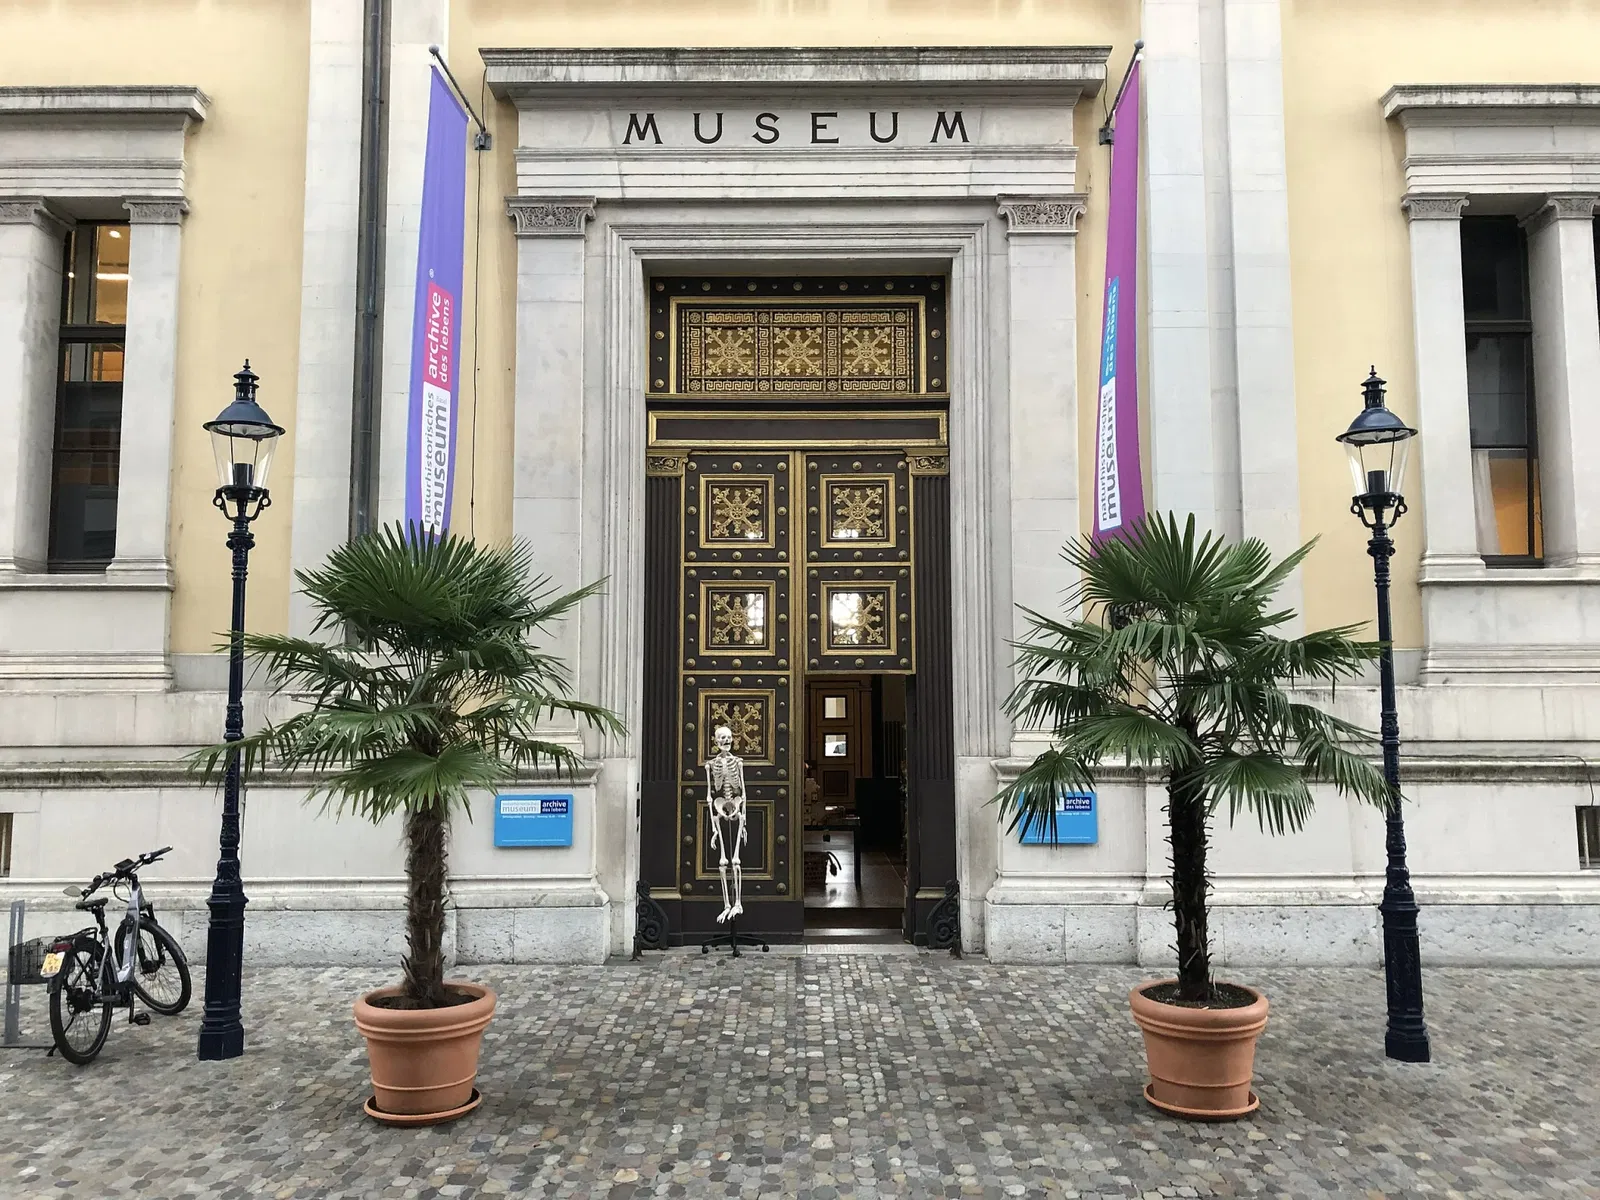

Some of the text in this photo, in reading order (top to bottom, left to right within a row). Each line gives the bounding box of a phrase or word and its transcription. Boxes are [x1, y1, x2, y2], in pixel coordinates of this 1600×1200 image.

[622, 111, 970, 145] MUSEUM
[427, 292, 441, 379] archive
[439, 298, 450, 383] des lebens
[424, 392, 434, 524] naturhistorisches
[433, 405, 447, 527] museum
[1100, 392, 1108, 521] naturhistorisches
[1106, 396, 1117, 520] museum
[1066, 797, 1090, 805] archive
